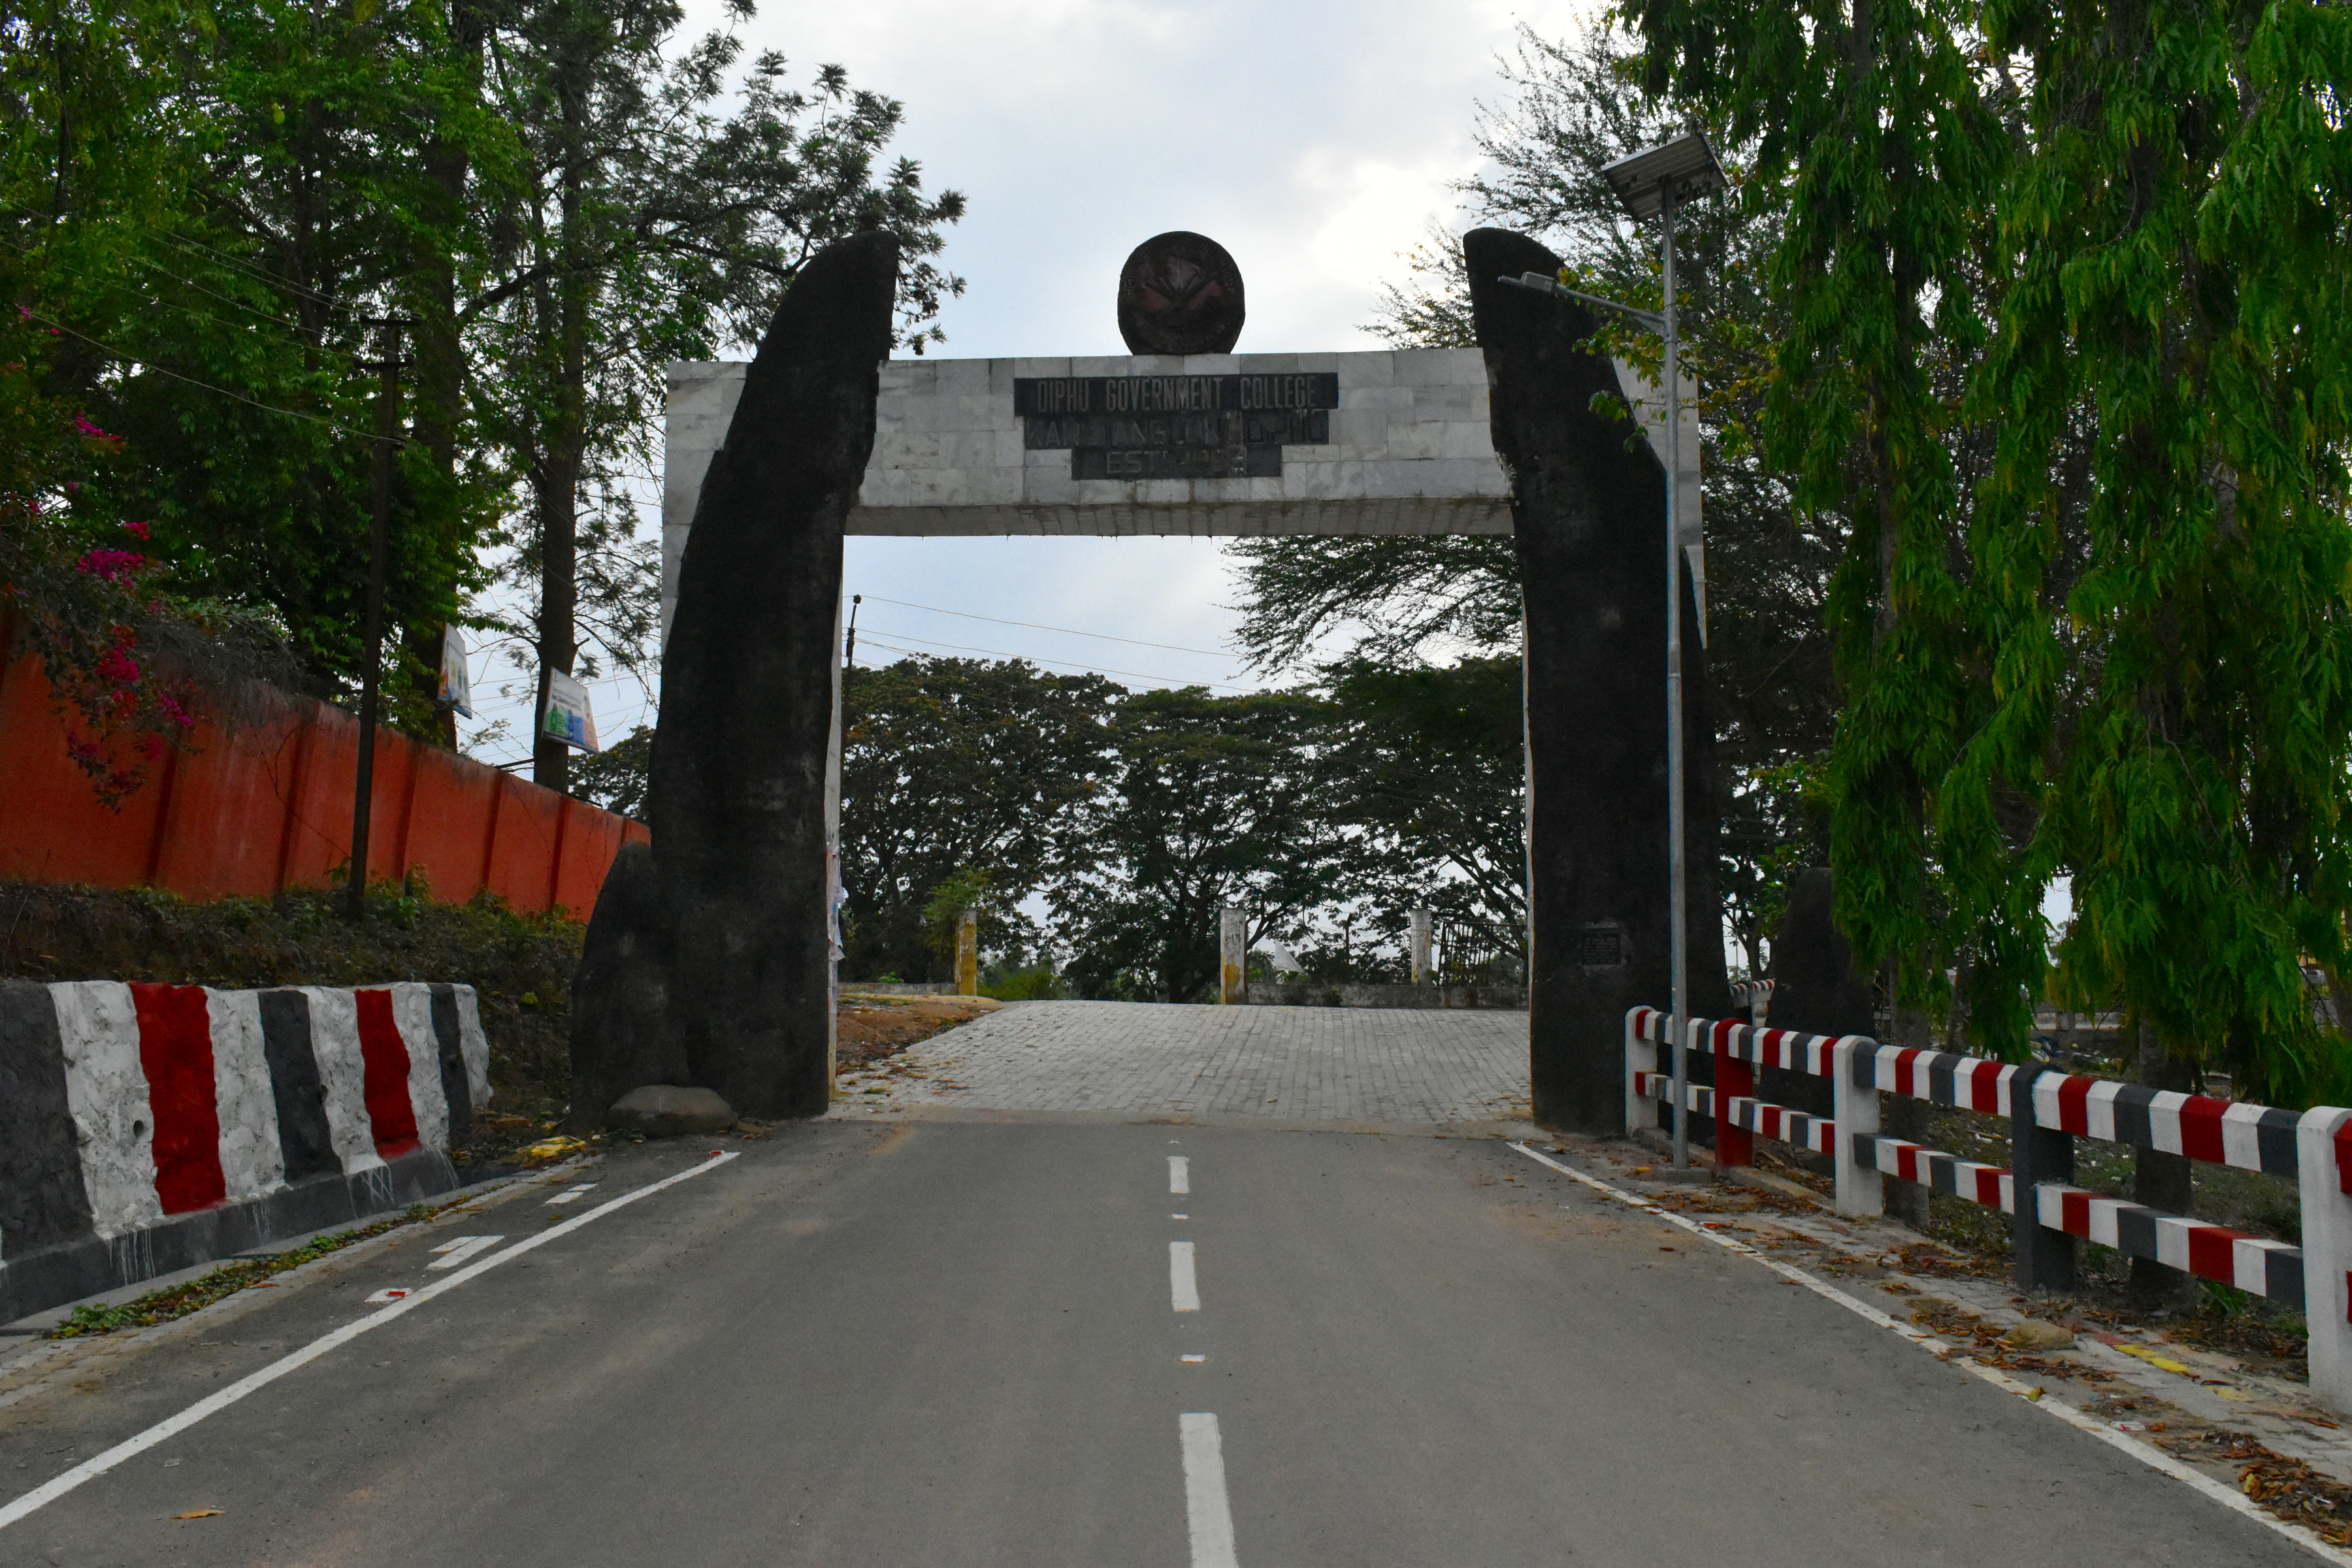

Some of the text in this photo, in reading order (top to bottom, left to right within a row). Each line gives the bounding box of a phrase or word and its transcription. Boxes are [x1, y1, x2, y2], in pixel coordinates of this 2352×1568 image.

[1037, 376, 1316, 413] DIPHU GOVERNMENT COLLEGE
